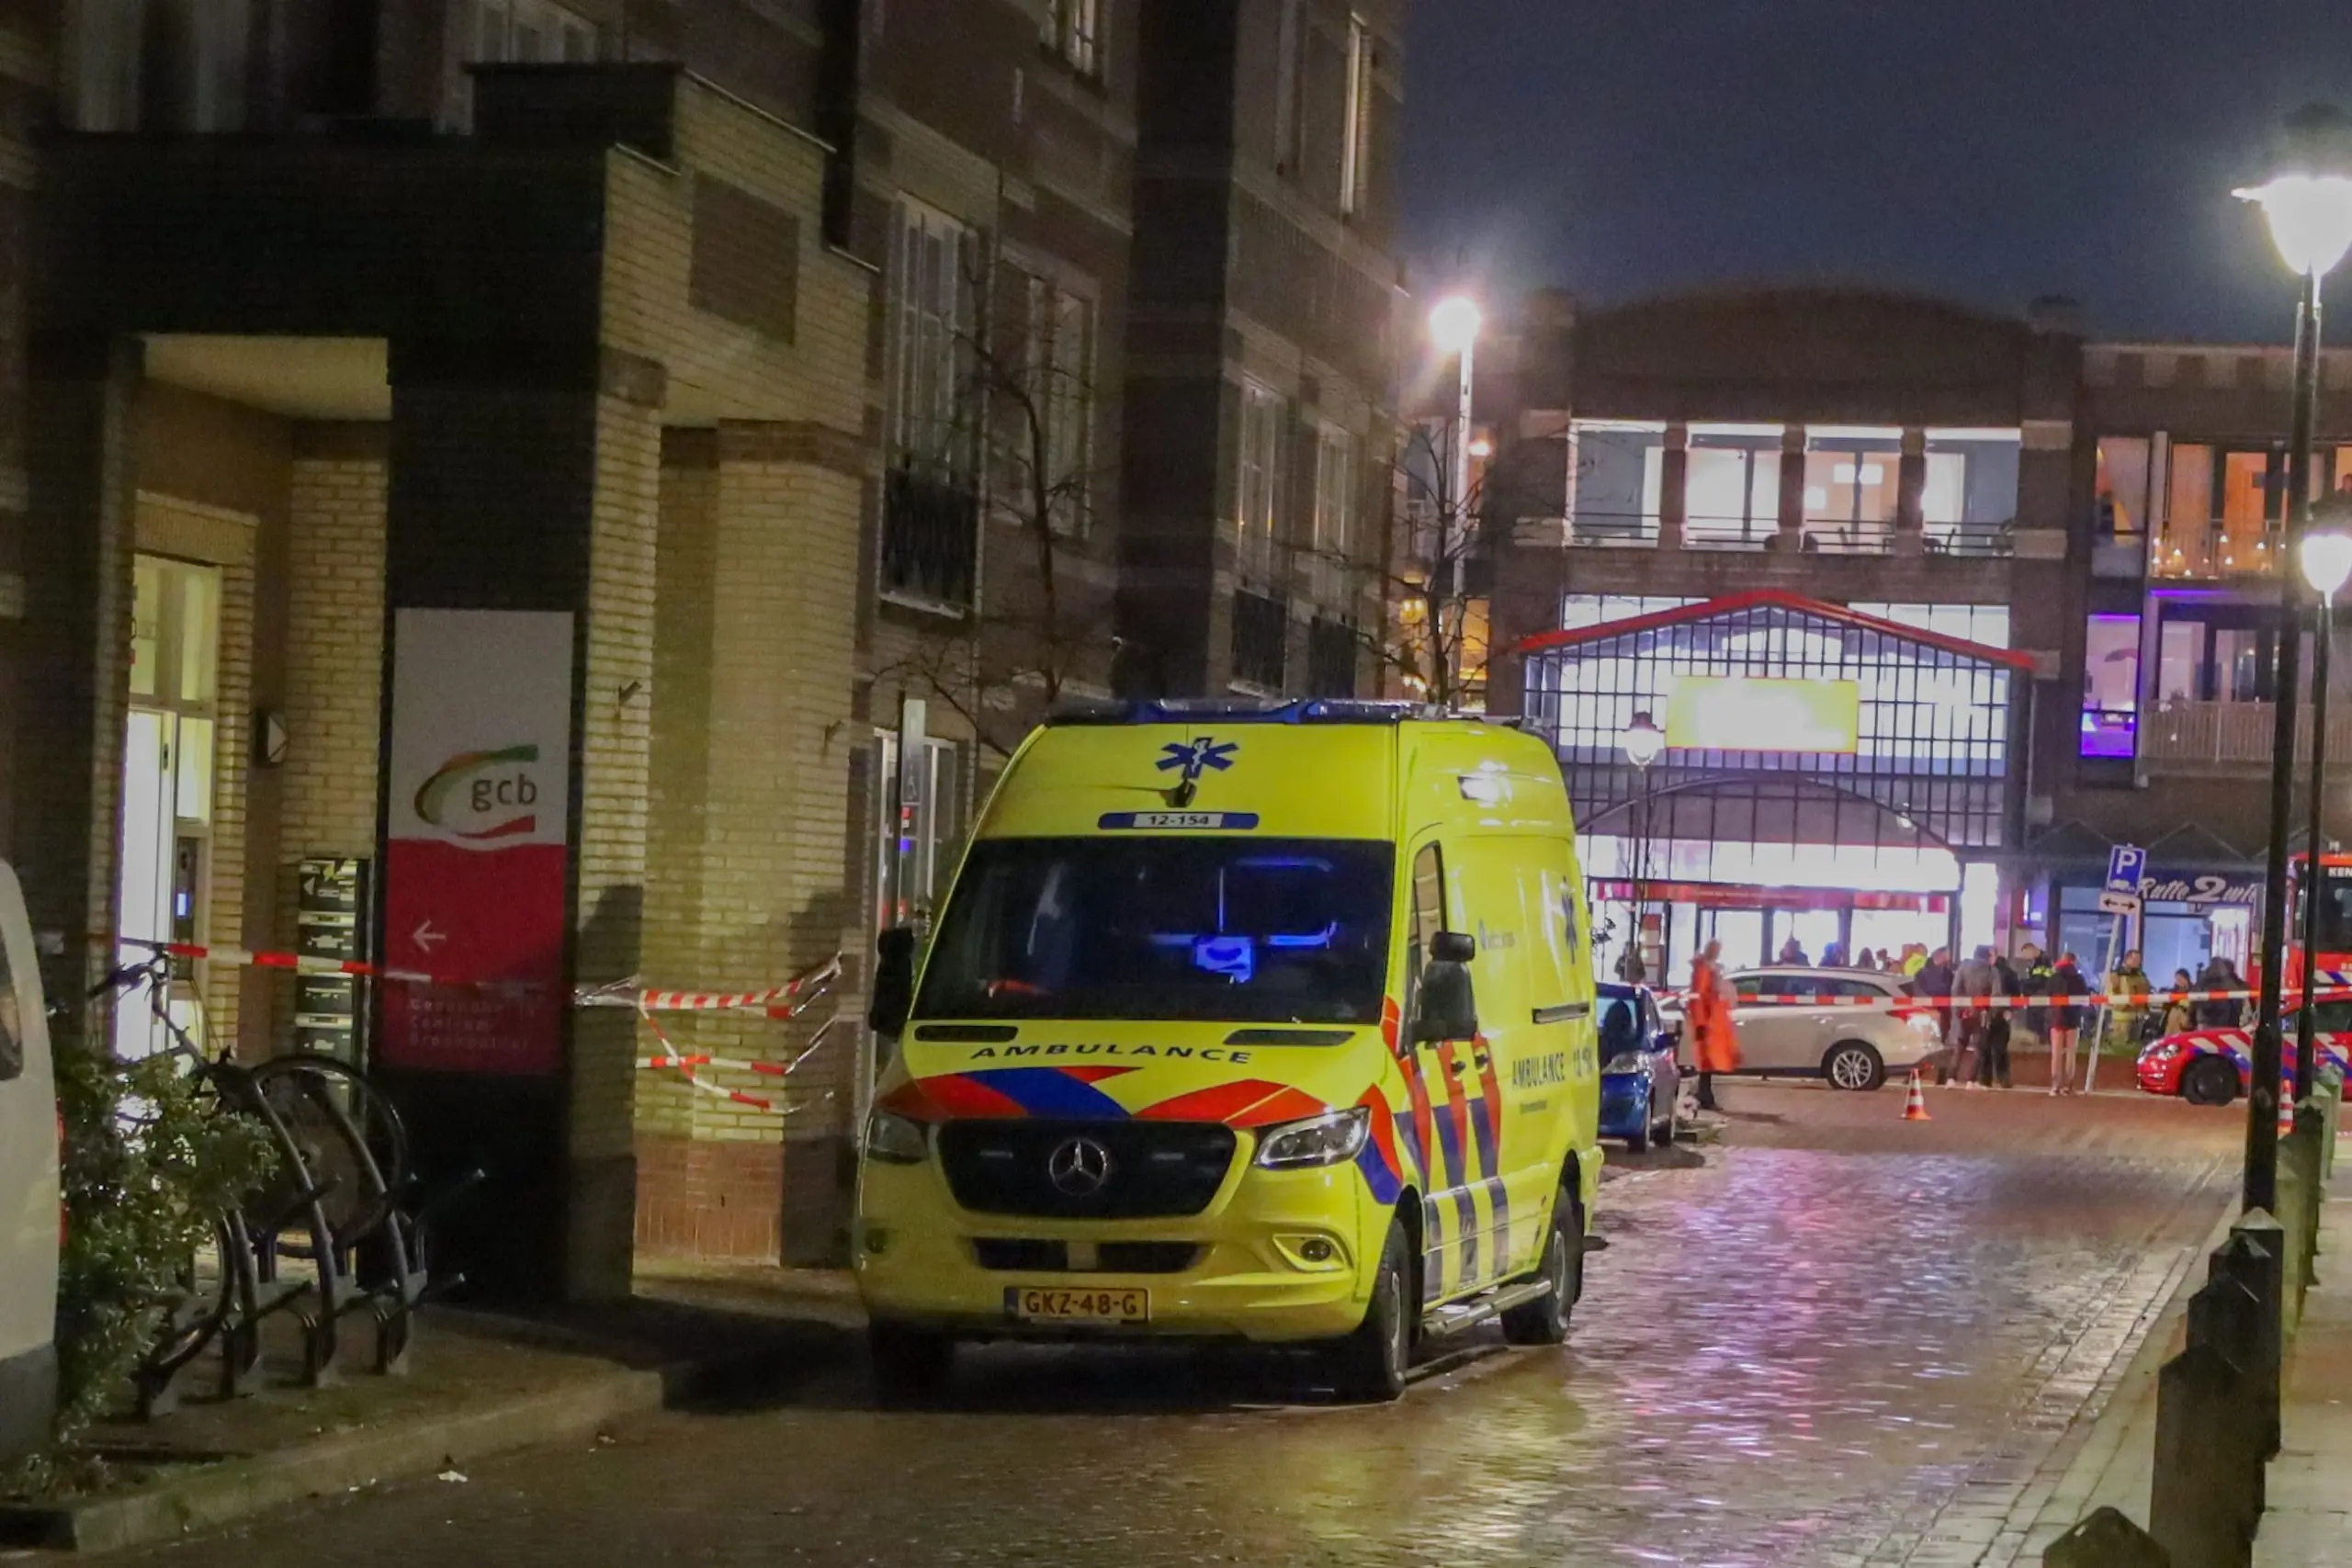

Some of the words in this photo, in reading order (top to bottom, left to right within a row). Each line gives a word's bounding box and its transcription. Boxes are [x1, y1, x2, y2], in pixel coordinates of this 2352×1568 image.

[472, 773, 537, 815] gcb
[1148, 815, 1210, 826] 12-154
[2116, 850, 2137, 875] P
[970, 1043, 1252, 1065] AMBULANCE
[1511, 1051, 1566, 1090] AMBULANCE
[1024, 1291, 1137, 1316] GKZ-48-G
